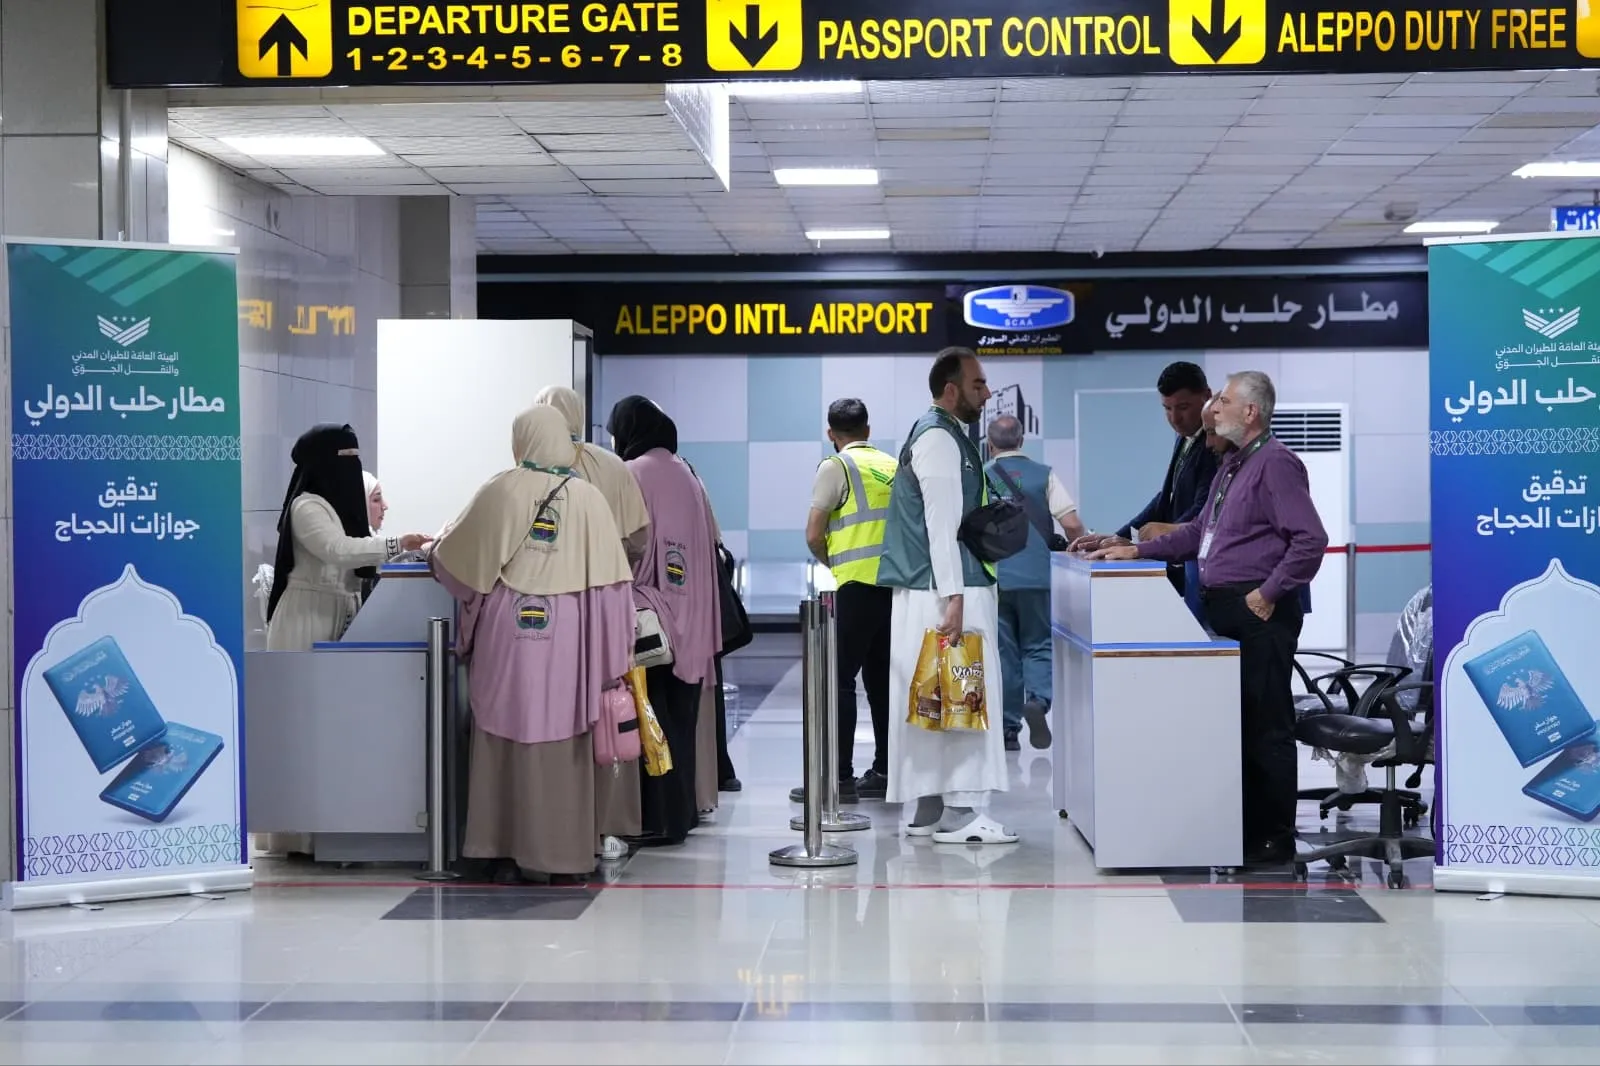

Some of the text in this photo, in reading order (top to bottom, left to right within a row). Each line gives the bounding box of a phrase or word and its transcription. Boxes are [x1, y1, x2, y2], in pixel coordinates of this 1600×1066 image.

[347, 1, 680, 36] DEPARTURE GATE
[1278, 7, 1567, 53] ALEPPO DUTY FREE
[819, 15, 1161, 60] PASSPORT CONTROL
[615, 301, 933, 336] ALEPPO INTL. AIRPORT
[1004, 318, 1033, 327] SCAA
[1105, 291, 1400, 338] مطار حلب الدولي
[24, 383, 225, 427] مطار حلب الدولي
[1444, 377, 1597, 424] حلب الدولي
[98, 475, 159, 509] تدقيق
[1522, 469, 1588, 503] تدقيق
[55, 512, 201, 543] جوازات الحجاج
[1476, 506, 1551, 536] الحجاج
